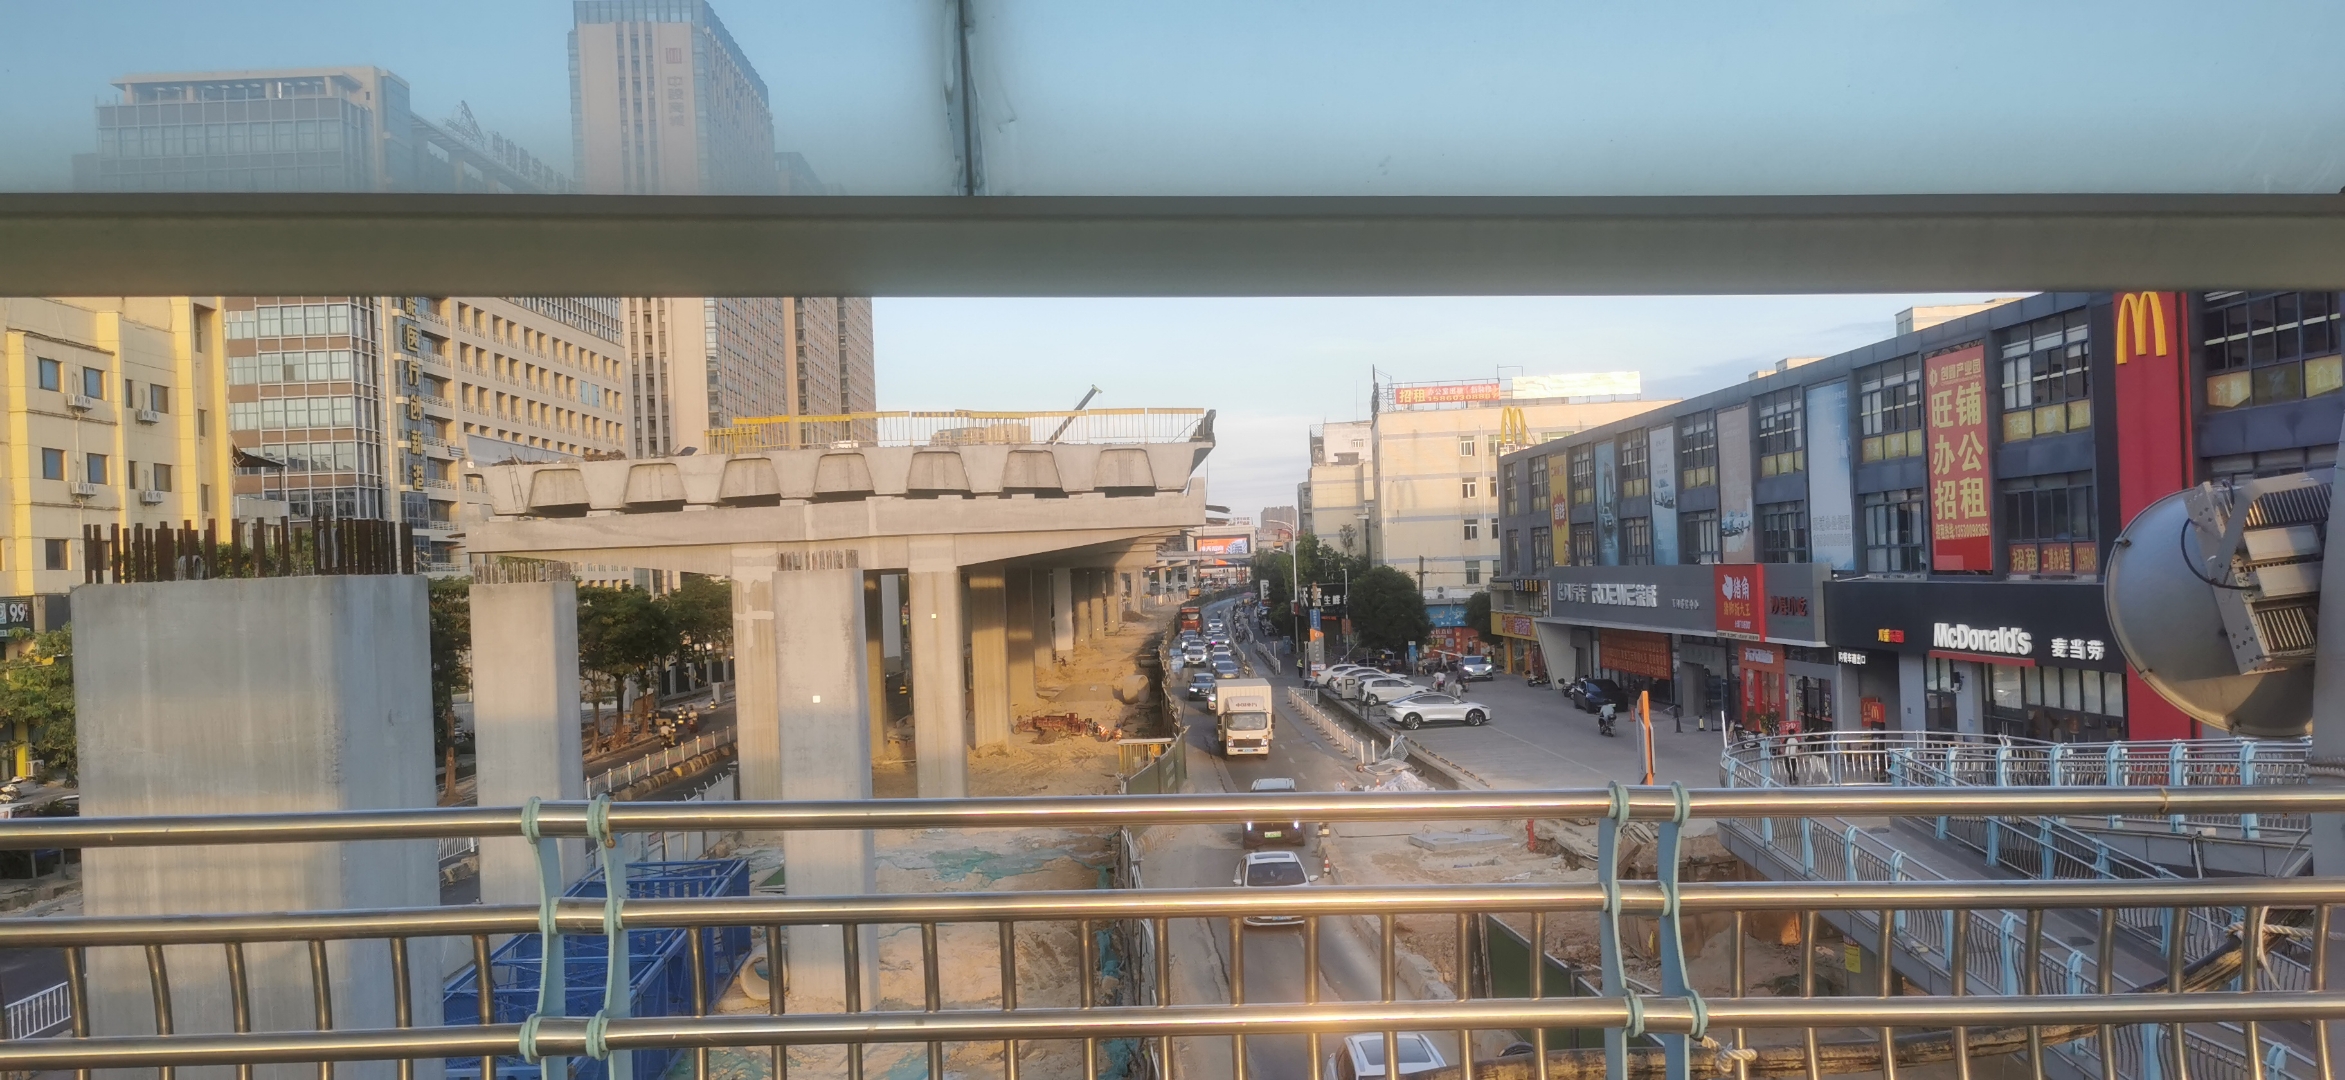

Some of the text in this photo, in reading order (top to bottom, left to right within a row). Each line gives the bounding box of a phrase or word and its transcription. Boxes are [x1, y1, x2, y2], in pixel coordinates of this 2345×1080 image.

[1399, 389, 1425, 403] 招租
[1931, 382, 1982, 428] 旺铺
[1933, 431, 1984, 475] 办公
[1934, 477, 1987, 520] 招租
[2012, 548, 2037, 571] 招租
[1933, 622, 2032, 655] McDonald's
[2051, 637, 2105, 661] 麦当劳
[1345, 678, 1355, 690] P
